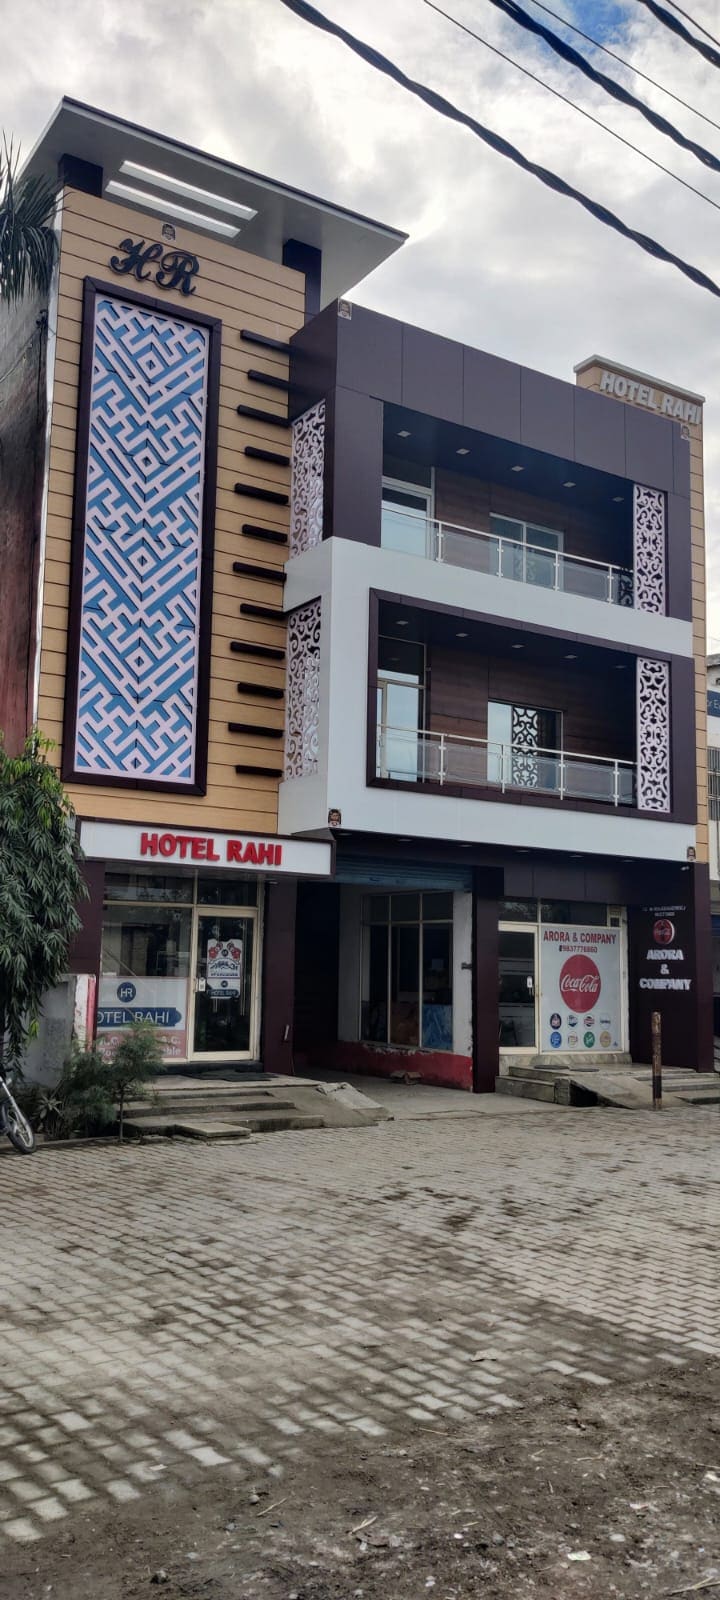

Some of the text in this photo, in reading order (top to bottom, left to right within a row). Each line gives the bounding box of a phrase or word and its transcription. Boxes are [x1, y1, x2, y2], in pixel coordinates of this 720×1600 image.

[109, 237, 200, 296] HR
[599, 371, 702, 424] HOTEL RAHI
[140, 832, 283, 866] HOTEL RAHI
[543, 930, 617, 944] ARORA & COMPANY
[646, 949, 684, 960] ARORA
[660, 963, 670, 974] &
[639, 978, 692, 990] COMPANY
[120, 987, 133, 997] HR
[97, 1011, 169, 1023] OTEL RAHI
